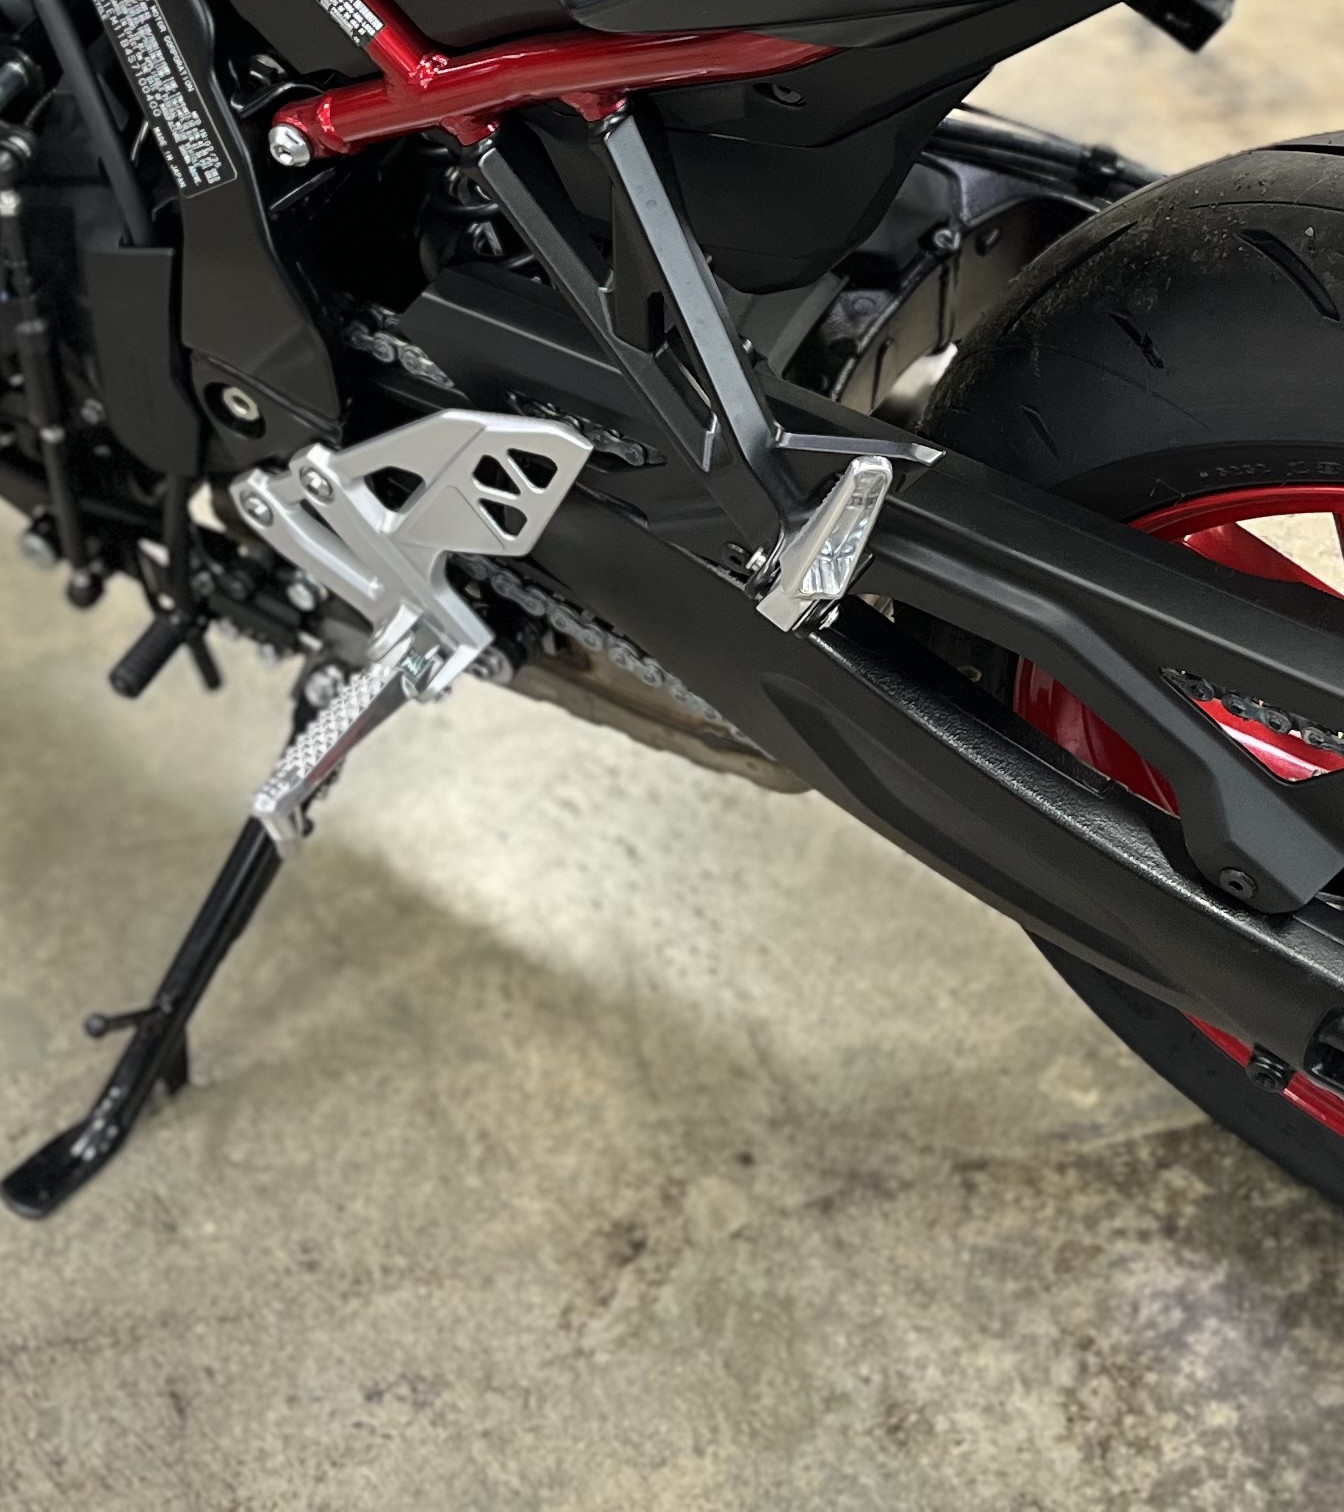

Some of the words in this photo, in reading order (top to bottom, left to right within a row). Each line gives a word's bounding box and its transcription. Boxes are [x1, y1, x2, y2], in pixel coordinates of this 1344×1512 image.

[148, 4, 167, 33] MOTOR
[162, 34, 195, 92] CORPORATION
[169, 162, 187, 189] JAPAN
